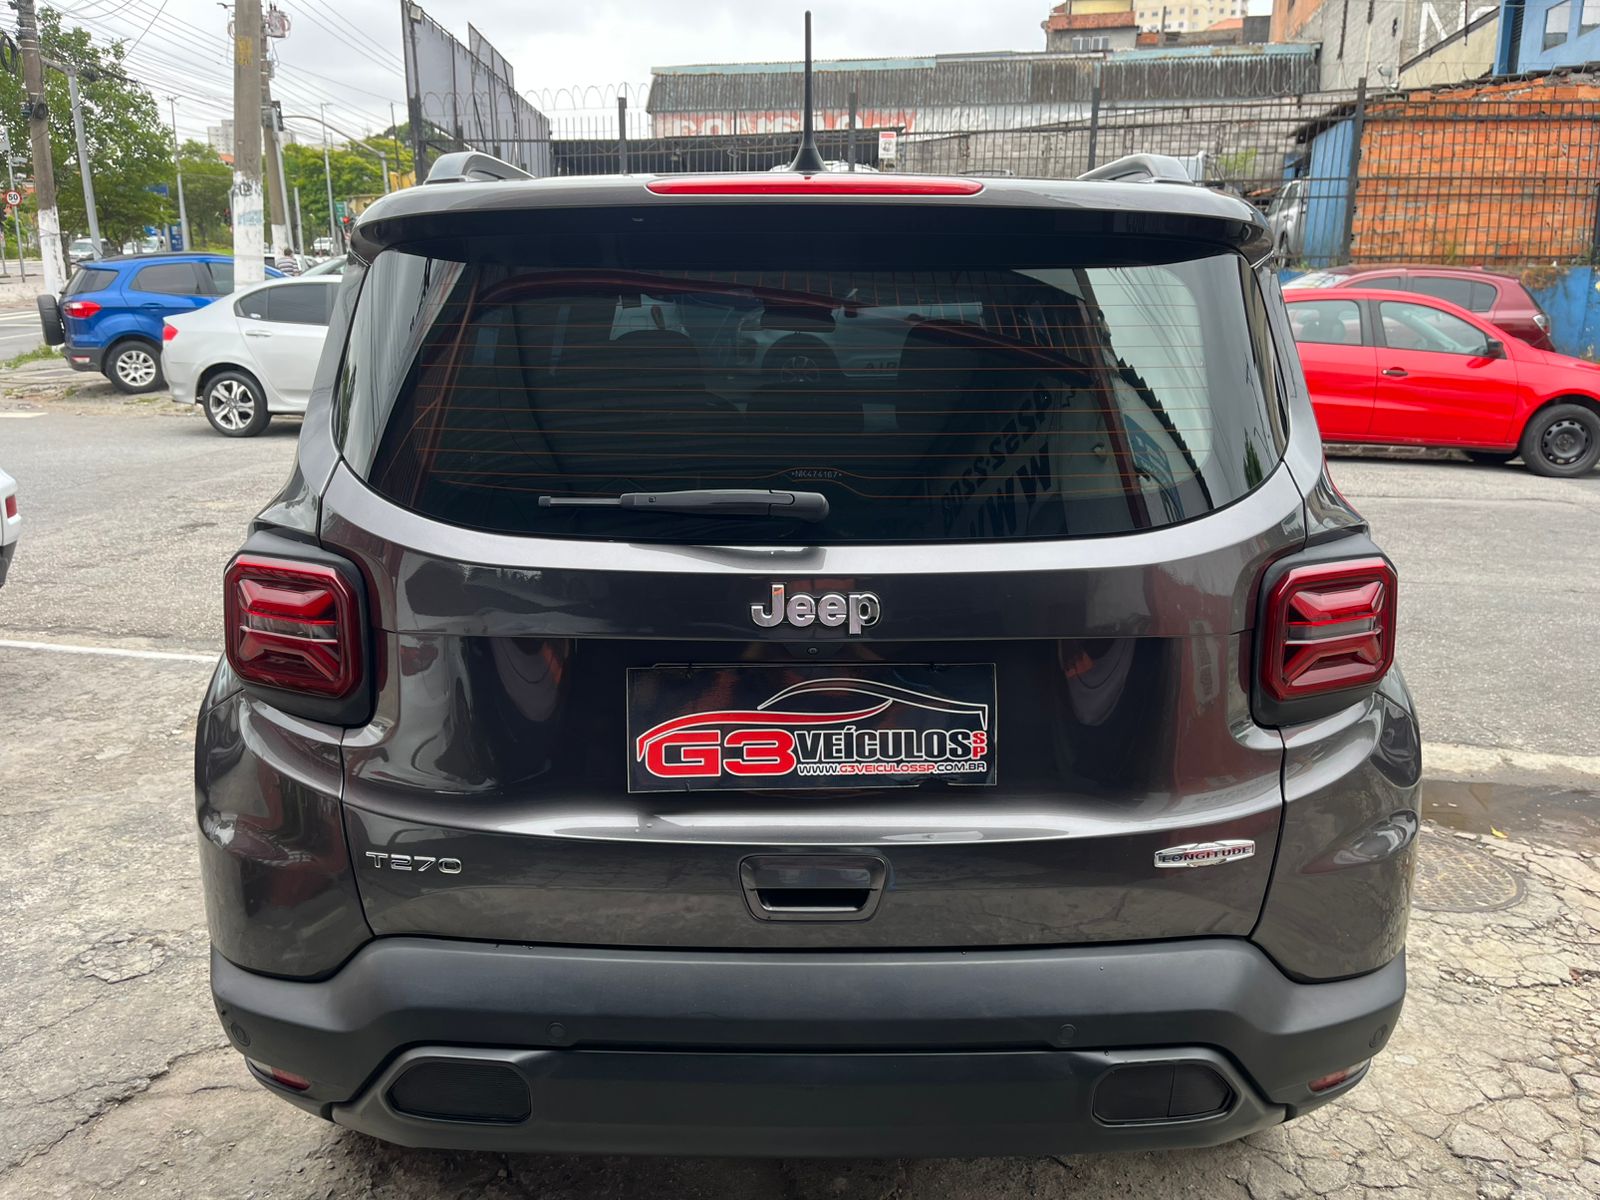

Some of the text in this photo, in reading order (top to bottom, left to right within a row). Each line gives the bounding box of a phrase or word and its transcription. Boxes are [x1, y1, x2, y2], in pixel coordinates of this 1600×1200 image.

[750, 583, 880, 635] Jeep
[646, 726, 973, 777] G3 VEÍCULOS
[797, 761, 987, 776] WWW.G3VEICULOSSP.COM.BR
[365, 851, 462, 874] T270
[1161, 845, 1251, 862] LONGITUDE
